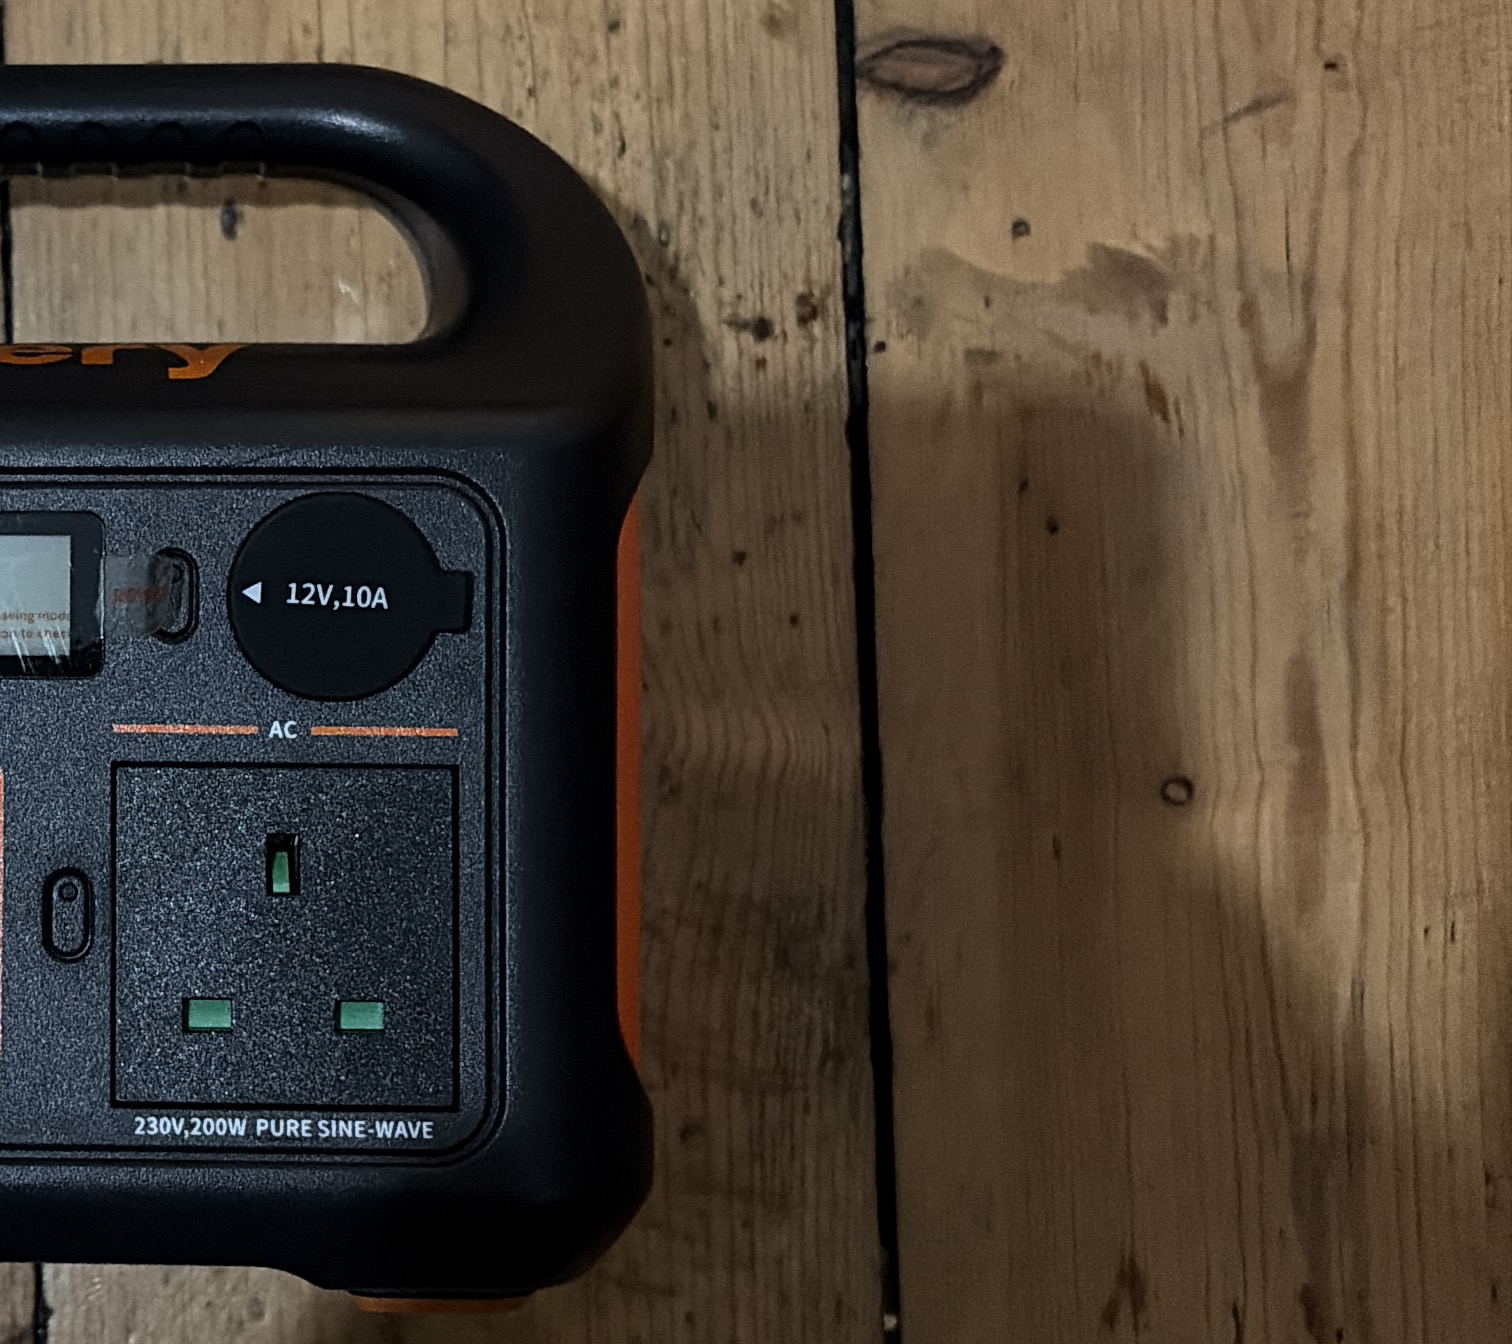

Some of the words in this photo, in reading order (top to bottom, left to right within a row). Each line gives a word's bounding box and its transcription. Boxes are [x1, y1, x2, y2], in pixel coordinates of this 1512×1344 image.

[285, 581, 389, 611] 12V,10A
[268, 720, 298, 740] AC
[134, 1117, 246, 1138] 230V,200W
[256, 1119, 313, 1138] PURE
[317, 1119, 434, 1140] SINE-WAVE
